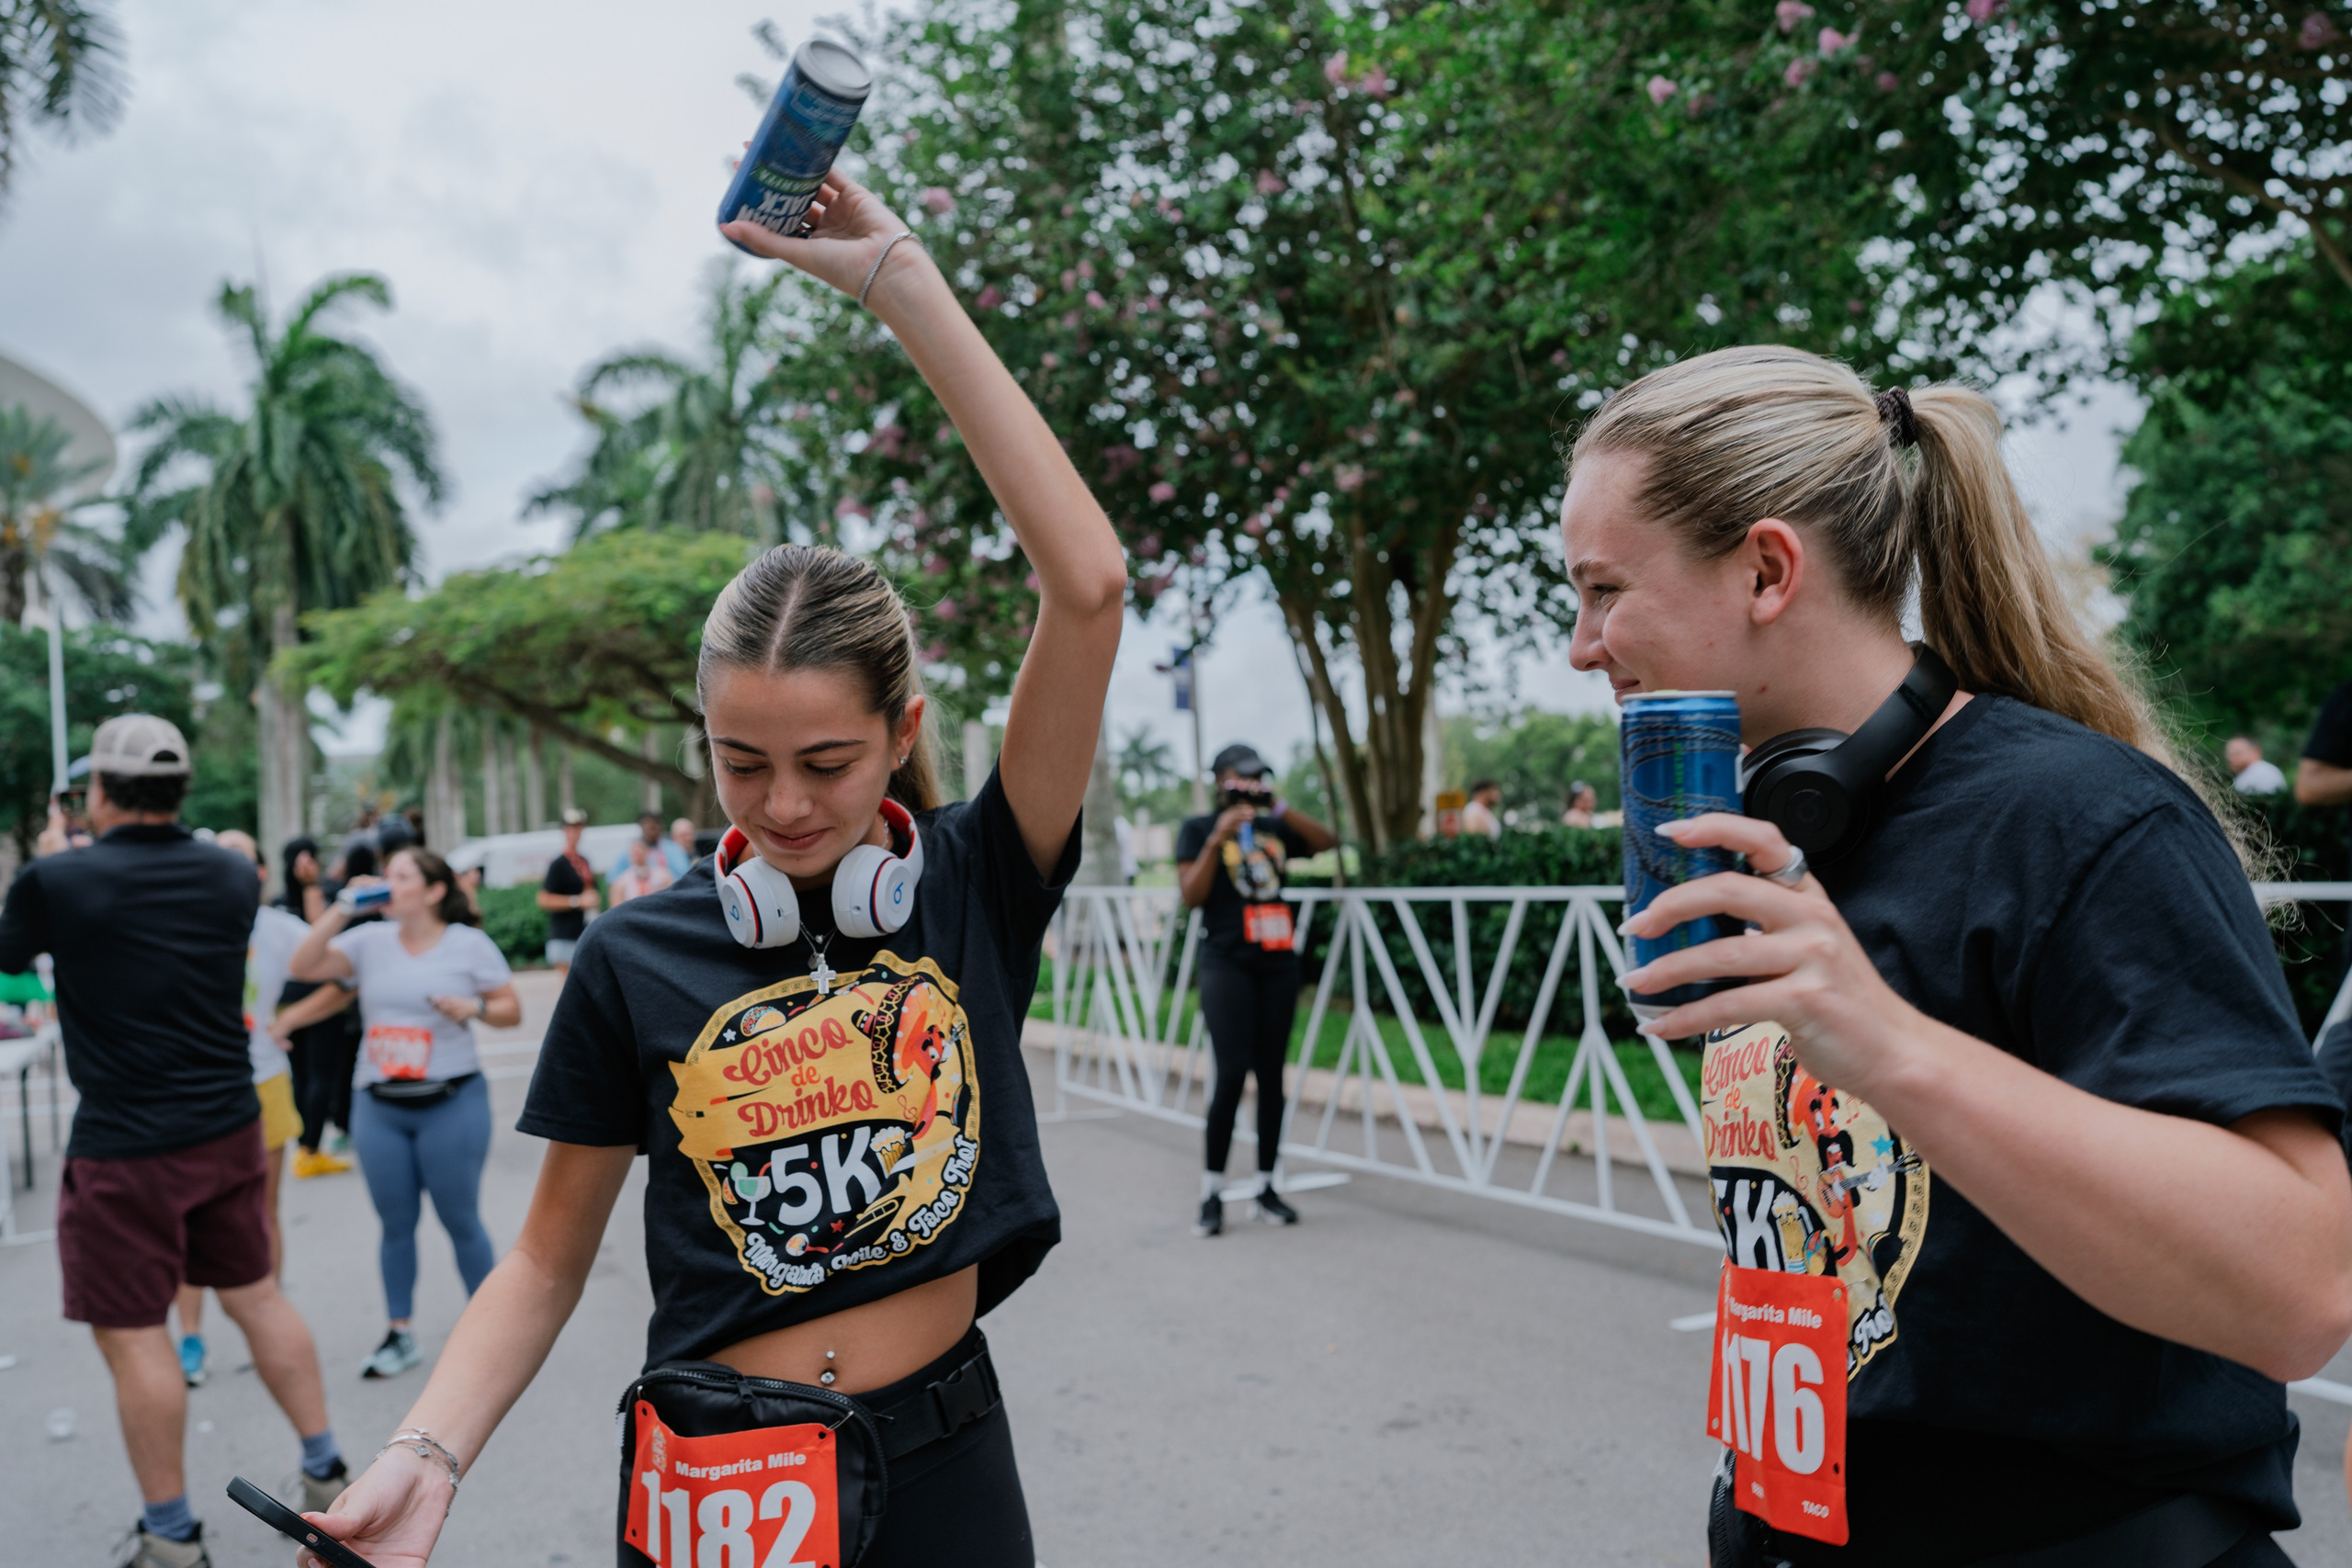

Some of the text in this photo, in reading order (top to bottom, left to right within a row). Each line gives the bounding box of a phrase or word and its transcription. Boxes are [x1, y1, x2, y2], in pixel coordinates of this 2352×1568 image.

[736, 203, 809, 235] AYMAN
[722, 1017, 854, 1087] Cinco
[1703, 1036, 1770, 1097] Cinco
[790, 1064, 821, 1089] de
[1724, 1082, 1743, 1111] de
[737, 1078, 879, 1138] Drinko
[770, 1125, 883, 1226] 5K
[745, 1232, 825, 1288] Margarita
[889, 1231, 909, 1252] &
[908, 1190, 960, 1238] Taco
[943, 1134, 978, 1185] Trot
[1788, 1306, 1823, 1329] Mile
[675, 1451, 807, 1481] Margarita Mile
[641, 1470, 817, 1568] 1182
[1801, 1500, 1830, 1519] TACO
